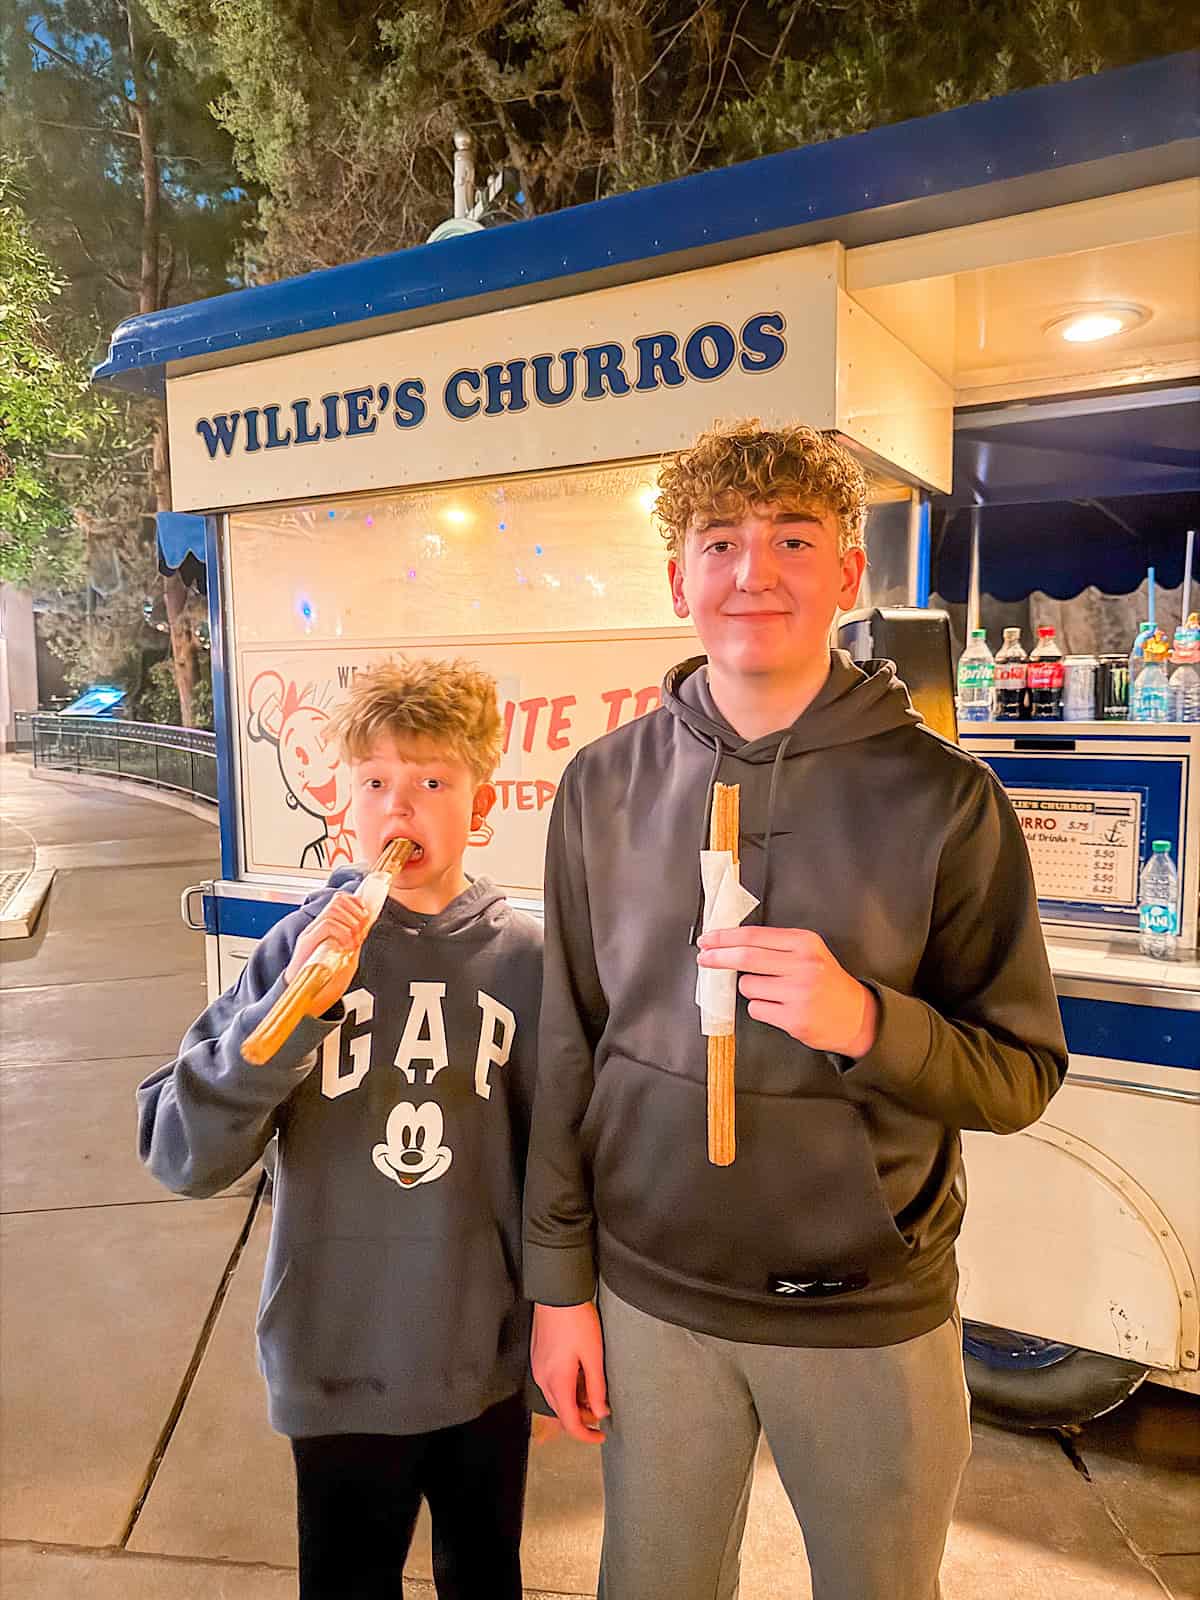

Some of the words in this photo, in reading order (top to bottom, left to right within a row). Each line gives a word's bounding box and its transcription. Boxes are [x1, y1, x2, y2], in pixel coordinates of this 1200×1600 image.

[196, 377, 426, 460] WILLIE'S
[443, 310, 787, 421] CHURROS
[337, 665, 358, 688] W
[502, 695, 577, 754] ITE
[321, 981, 516, 1101] GAP
